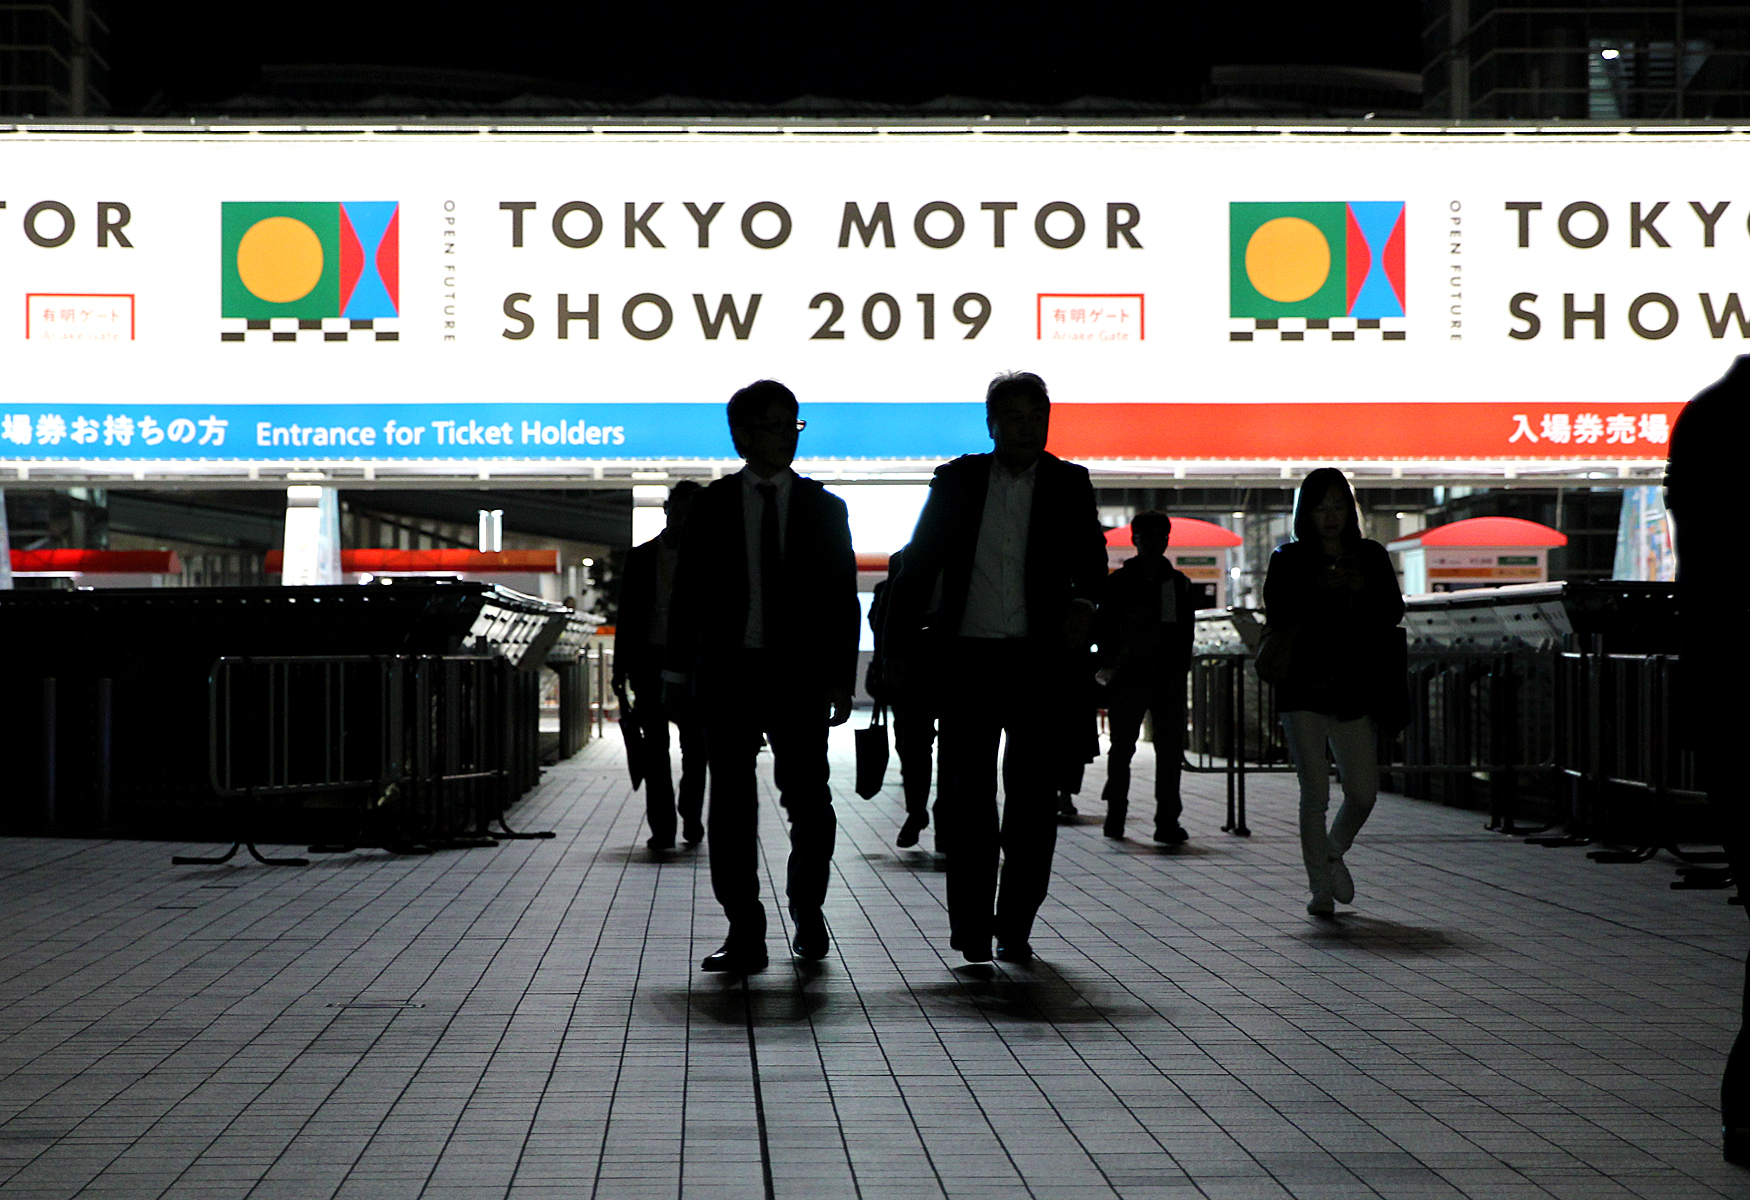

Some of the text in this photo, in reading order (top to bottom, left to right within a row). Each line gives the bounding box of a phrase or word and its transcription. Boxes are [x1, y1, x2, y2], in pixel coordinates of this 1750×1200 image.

[0, 200, 134, 249] OR
[499, 200, 1144, 250] TOKYO MOTOR
[1504, 200, 1750, 250] TOKY
[443, 199, 456, 342] OPEN FUTURE
[1449, 199, 1463, 342] OPEN FUTURE
[42, 307, 119, 324] 有明ゲート
[501, 292, 992, 342] SHOW 2019
[1052, 307, 1130, 325] 有明ゲート
[1098, 330, 1130, 342] Gate
[1508, 291, 1750, 341] SHOW
[1, 413, 229, 446] 場券お持ちの方
[256, 419, 625, 447] Entrance for Ticket Holders
[1508, 413, 1670, 444] 入場券売場
